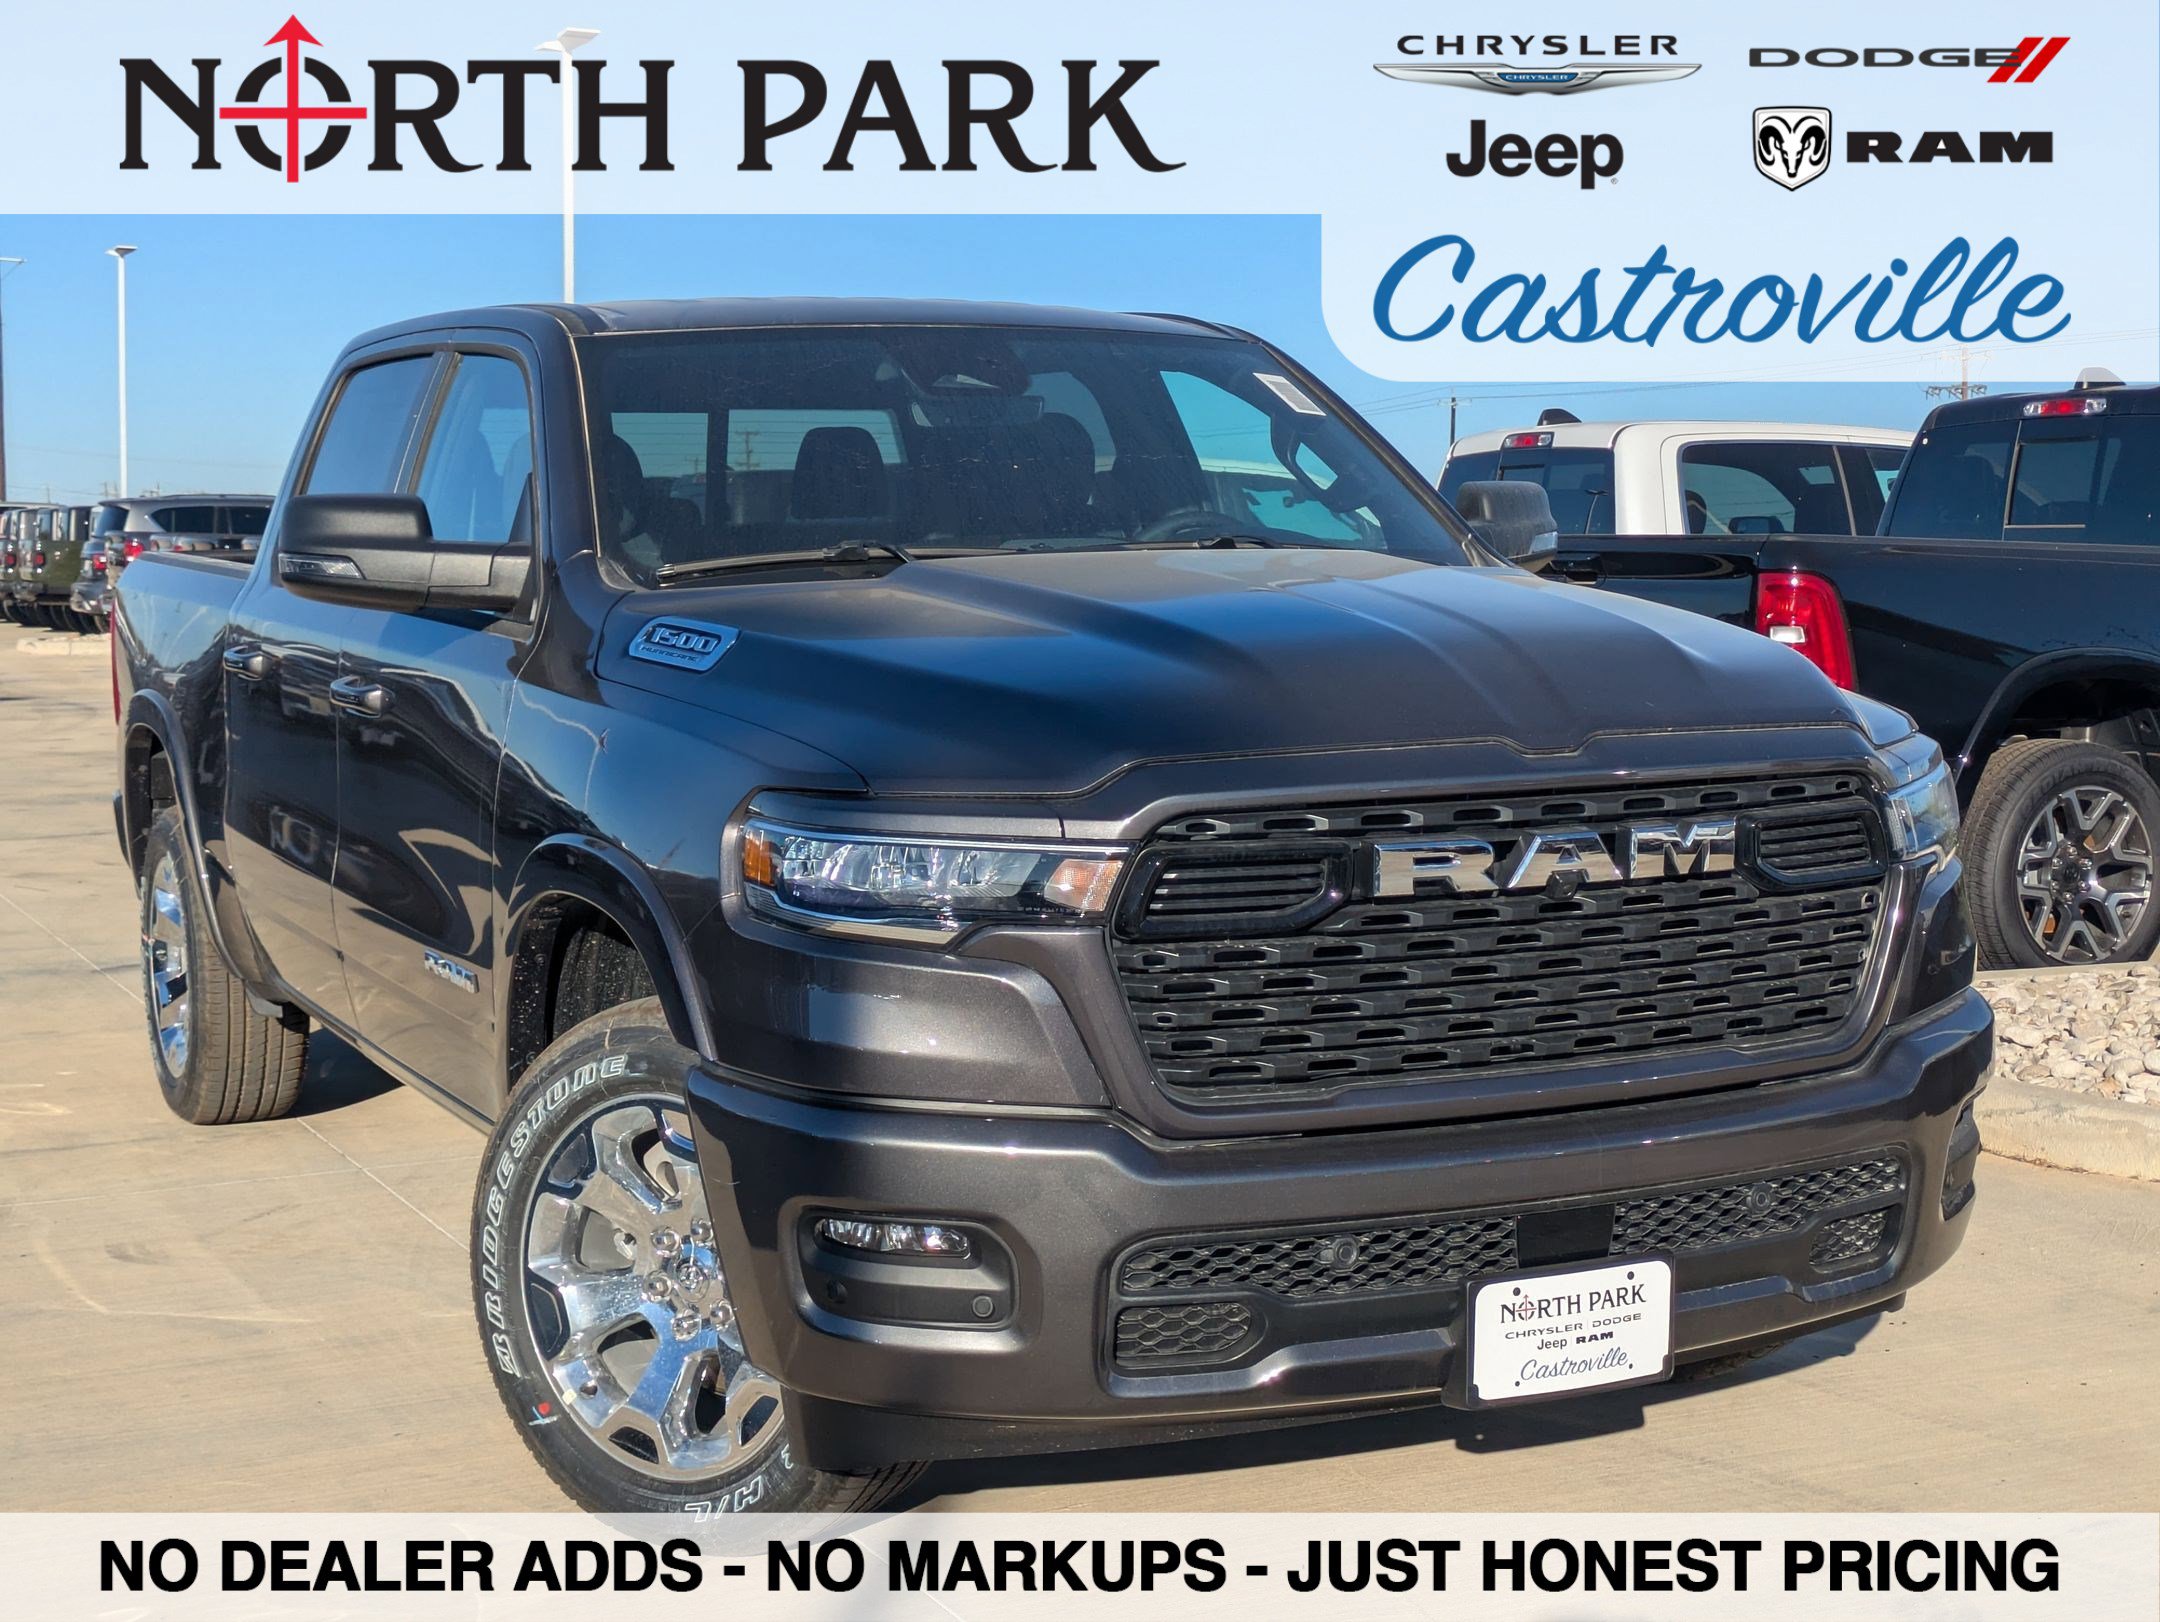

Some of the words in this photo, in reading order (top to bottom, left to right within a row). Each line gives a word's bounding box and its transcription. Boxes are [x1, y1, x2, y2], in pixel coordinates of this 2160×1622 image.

[650, 627, 719, 653] 1500
[1364, 815, 1736, 898] RAM
[424, 949, 480, 994] RAM
[483, 1055, 628, 1378] BRIDGESTONE
[1500, 1293, 1581, 1324] NORTH
[1588, 1283, 1647, 1312] PARK
[1504, 1322, 1583, 1340] CHRYSLER
[1592, 1312, 1642, 1328] DODGE
[1536, 1336, 1568, 1350] Jeep
[1575, 1330, 1614, 1345] RAM
[1519, 1346, 1629, 1381] Castroville
